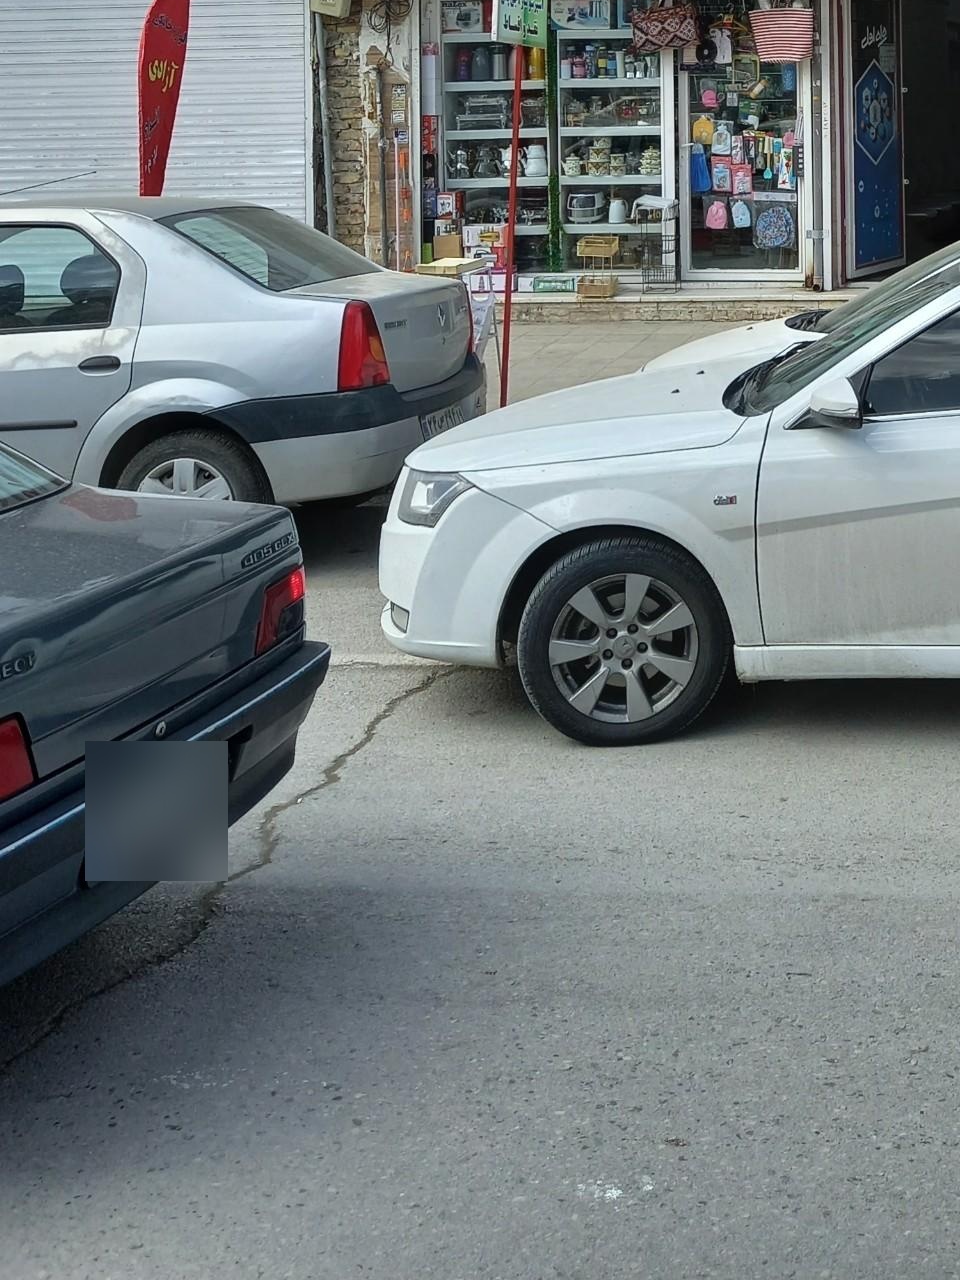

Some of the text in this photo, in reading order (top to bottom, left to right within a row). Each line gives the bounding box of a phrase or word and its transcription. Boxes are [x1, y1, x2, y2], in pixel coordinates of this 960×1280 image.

[149, 58, 180, 93] آزادی
[244, 533, 295, 566] 405 GLX
